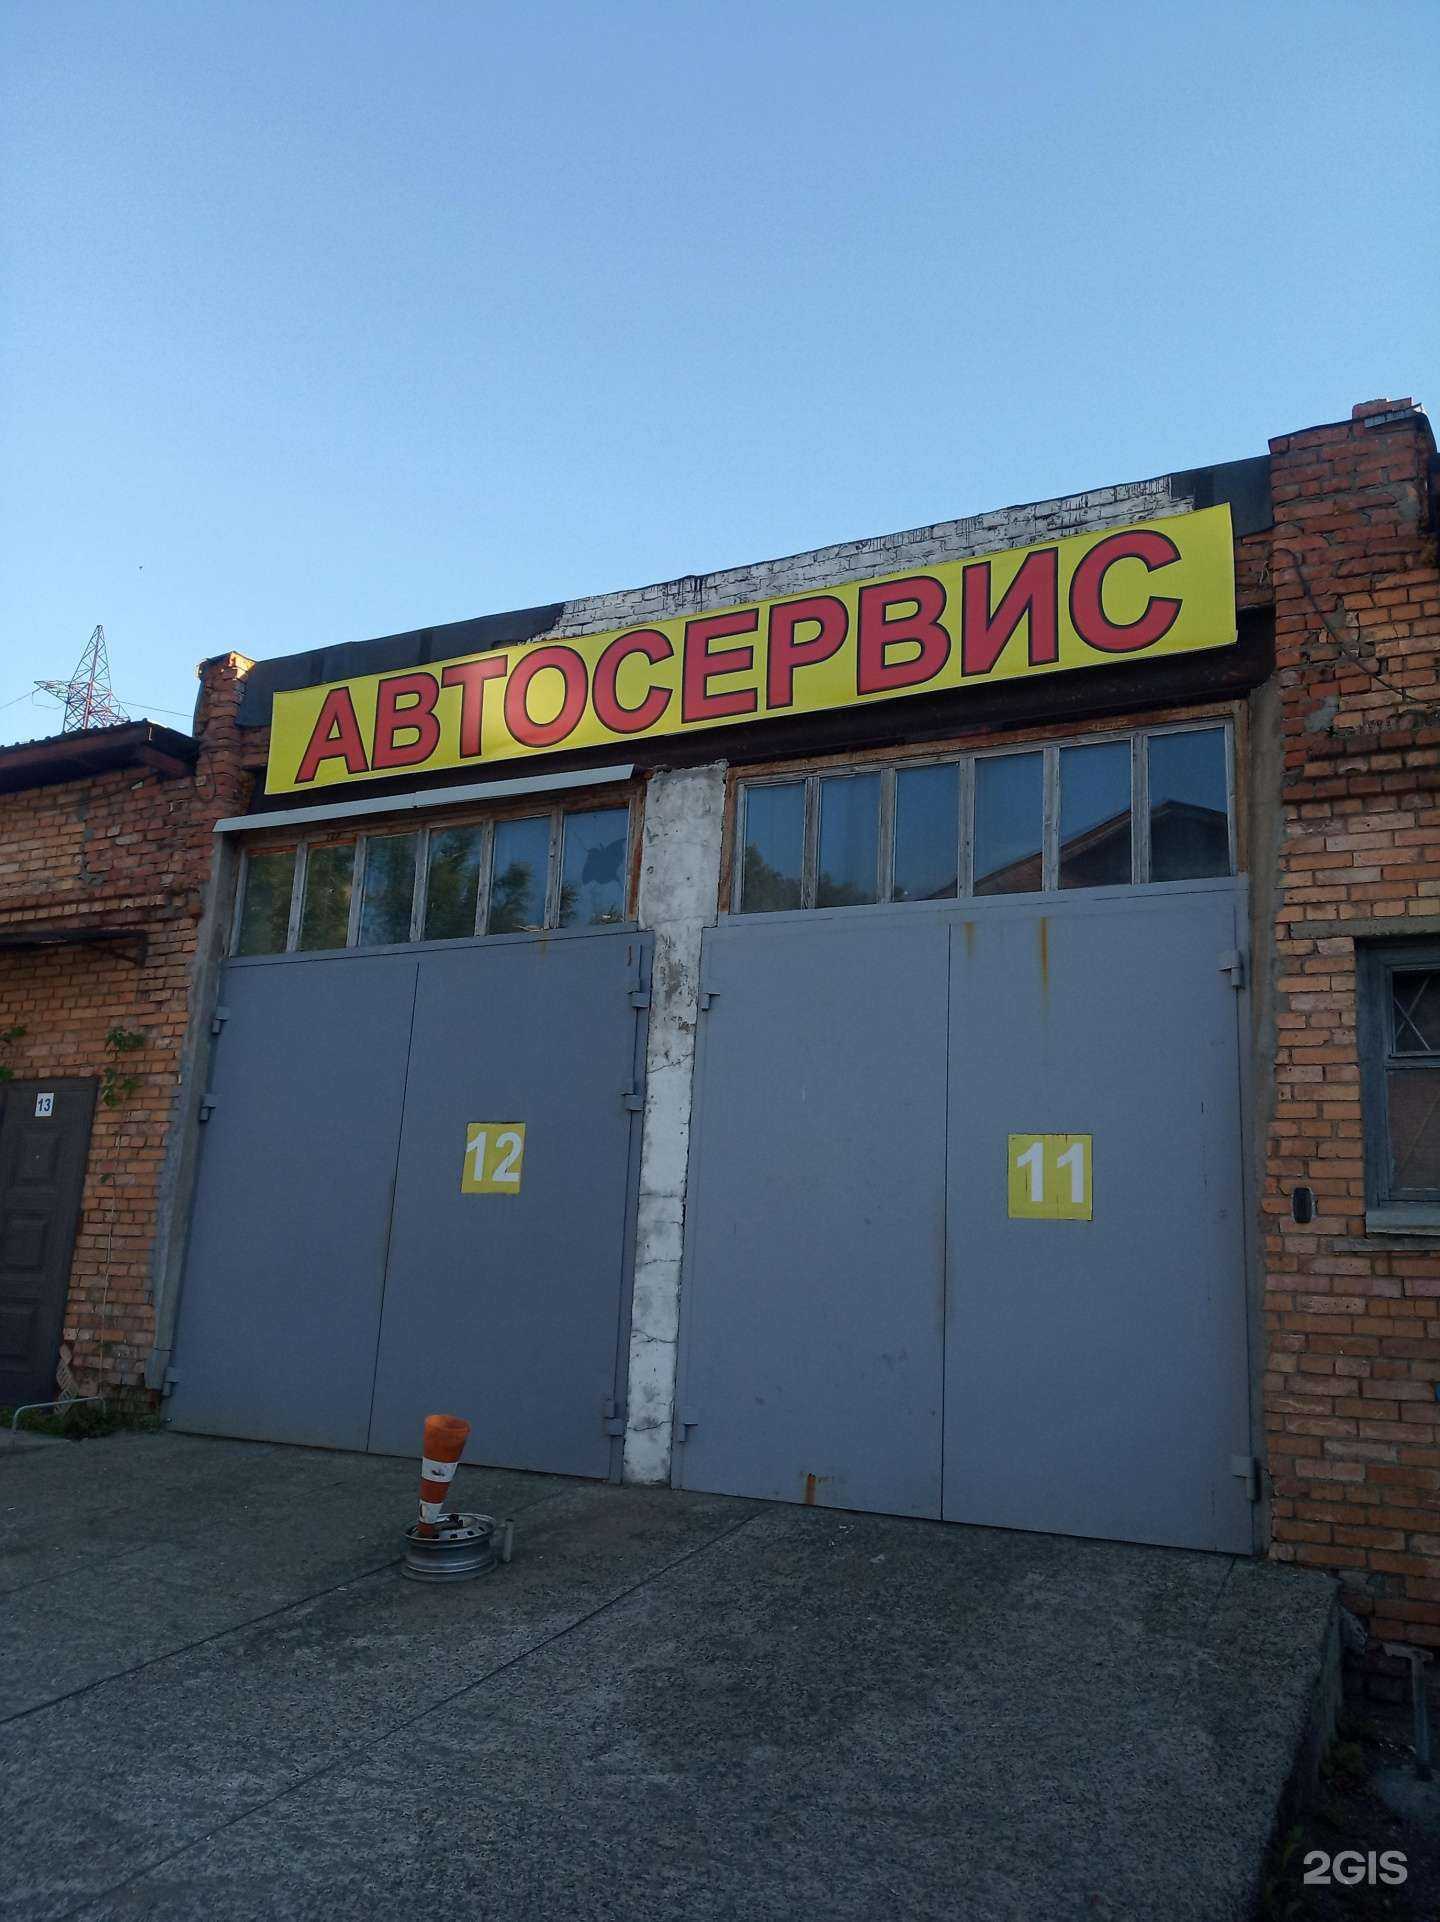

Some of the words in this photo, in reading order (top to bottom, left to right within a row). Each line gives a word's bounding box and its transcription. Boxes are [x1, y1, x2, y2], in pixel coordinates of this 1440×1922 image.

[294, 528, 1184, 784] АВТОСЕРВИС
[38, 1098, 51, 1112] 13
[466, 1131, 522, 1182] 12
[1016, 1142, 1084, 1204] 11
